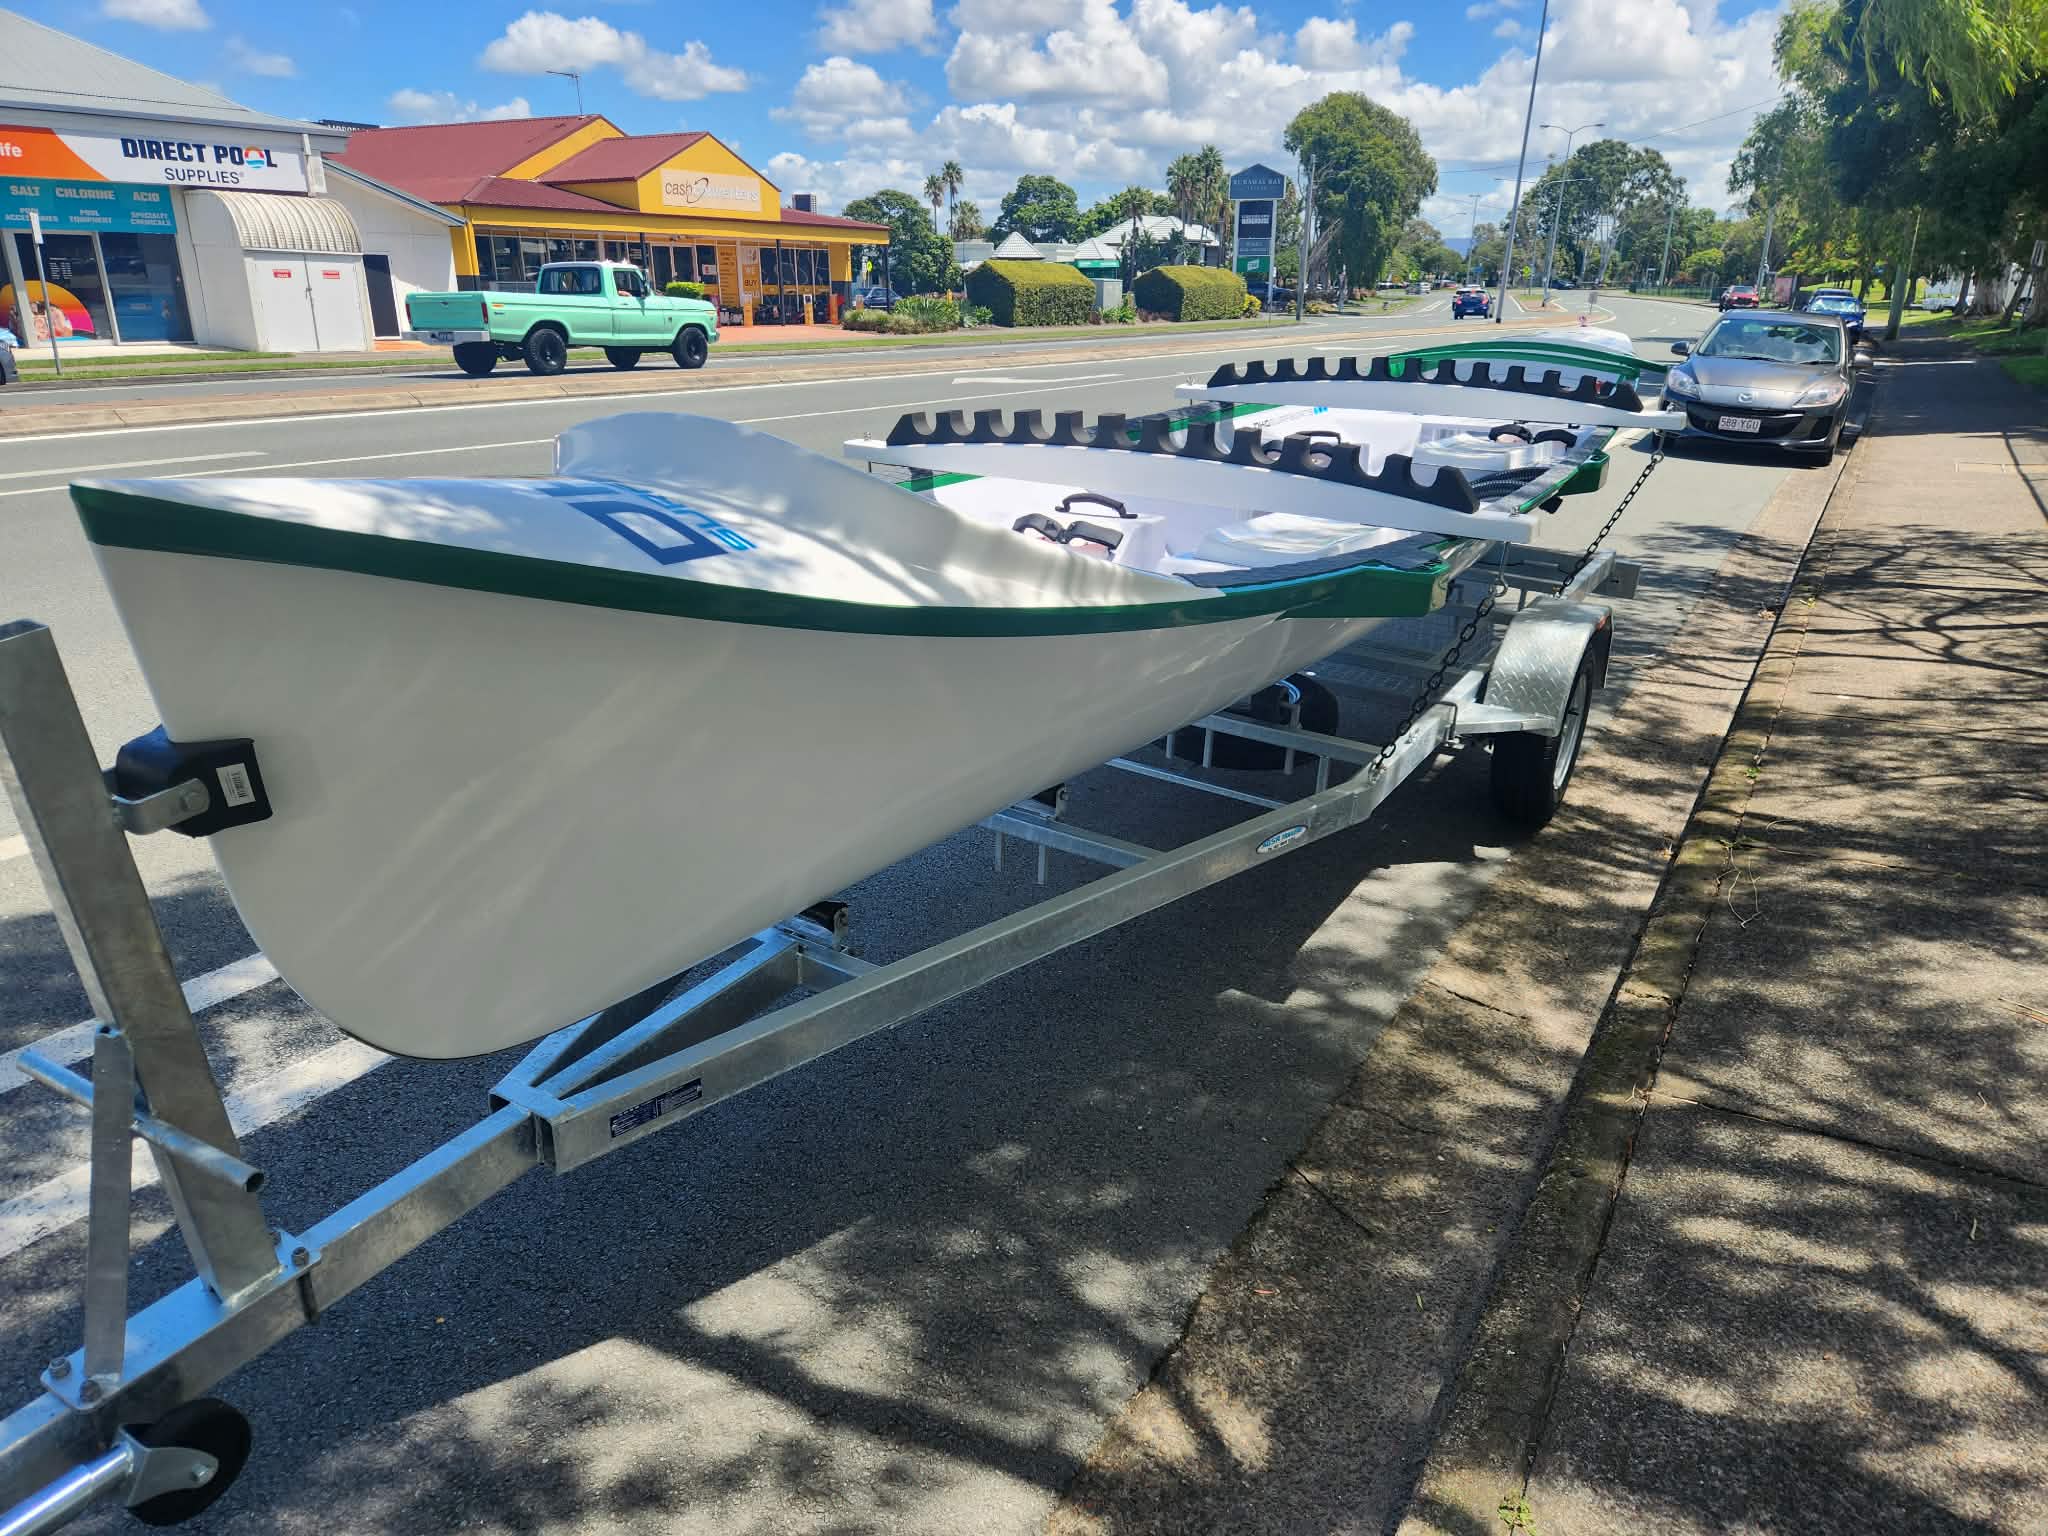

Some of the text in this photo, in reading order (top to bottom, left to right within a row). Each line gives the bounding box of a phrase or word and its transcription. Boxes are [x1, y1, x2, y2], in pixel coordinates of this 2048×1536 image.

[120, 138, 278, 169] DIRECT POOL
[164, 167, 240, 185] SUPPLIES
[9, 185, 41, 197] SALT
[55, 187, 116, 200] CHLORINE
[664, 179, 693, 197] cash
[133, 191, 161, 202] ACID
[79, 209, 100, 217] POOL
[744, 279, 758, 287] BUY
